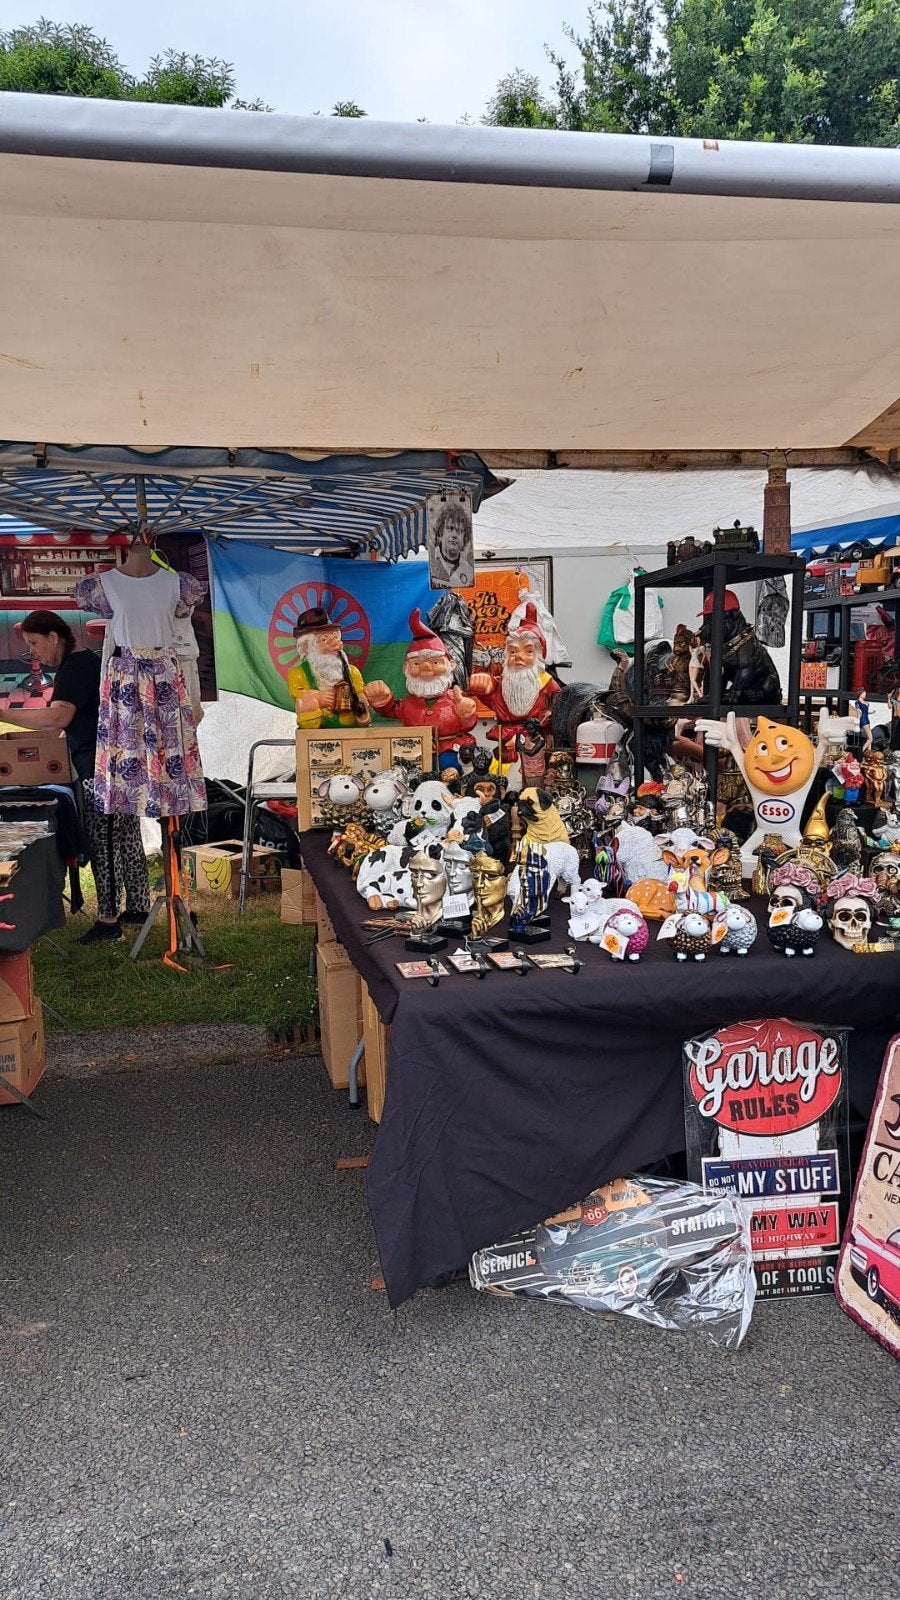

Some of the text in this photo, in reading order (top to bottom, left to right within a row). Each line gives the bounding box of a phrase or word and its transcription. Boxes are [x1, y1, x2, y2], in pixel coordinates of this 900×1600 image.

[475, 591, 497, 607] It's
[474, 618, 509, 636] lock
[683, 1038, 839, 1117] Garage
[729, 1093, 799, 1121] RULES
[748, 1161, 775, 1170] AVOID
[709, 1174, 735, 1187] DO NOT
[738, 1166, 832, 1194] MY STUFF
[586, 1207, 602, 1221] 66
[671, 1209, 726, 1236] STATION
[752, 1209, 830, 1232] MY WAY
[752, 1236, 765, 1244] HE
[768, 1232, 815, 1243] HIGHWAY
[482, 1250, 536, 1275] SERVICE
[761, 1266, 834, 1286] OF TOOLS
